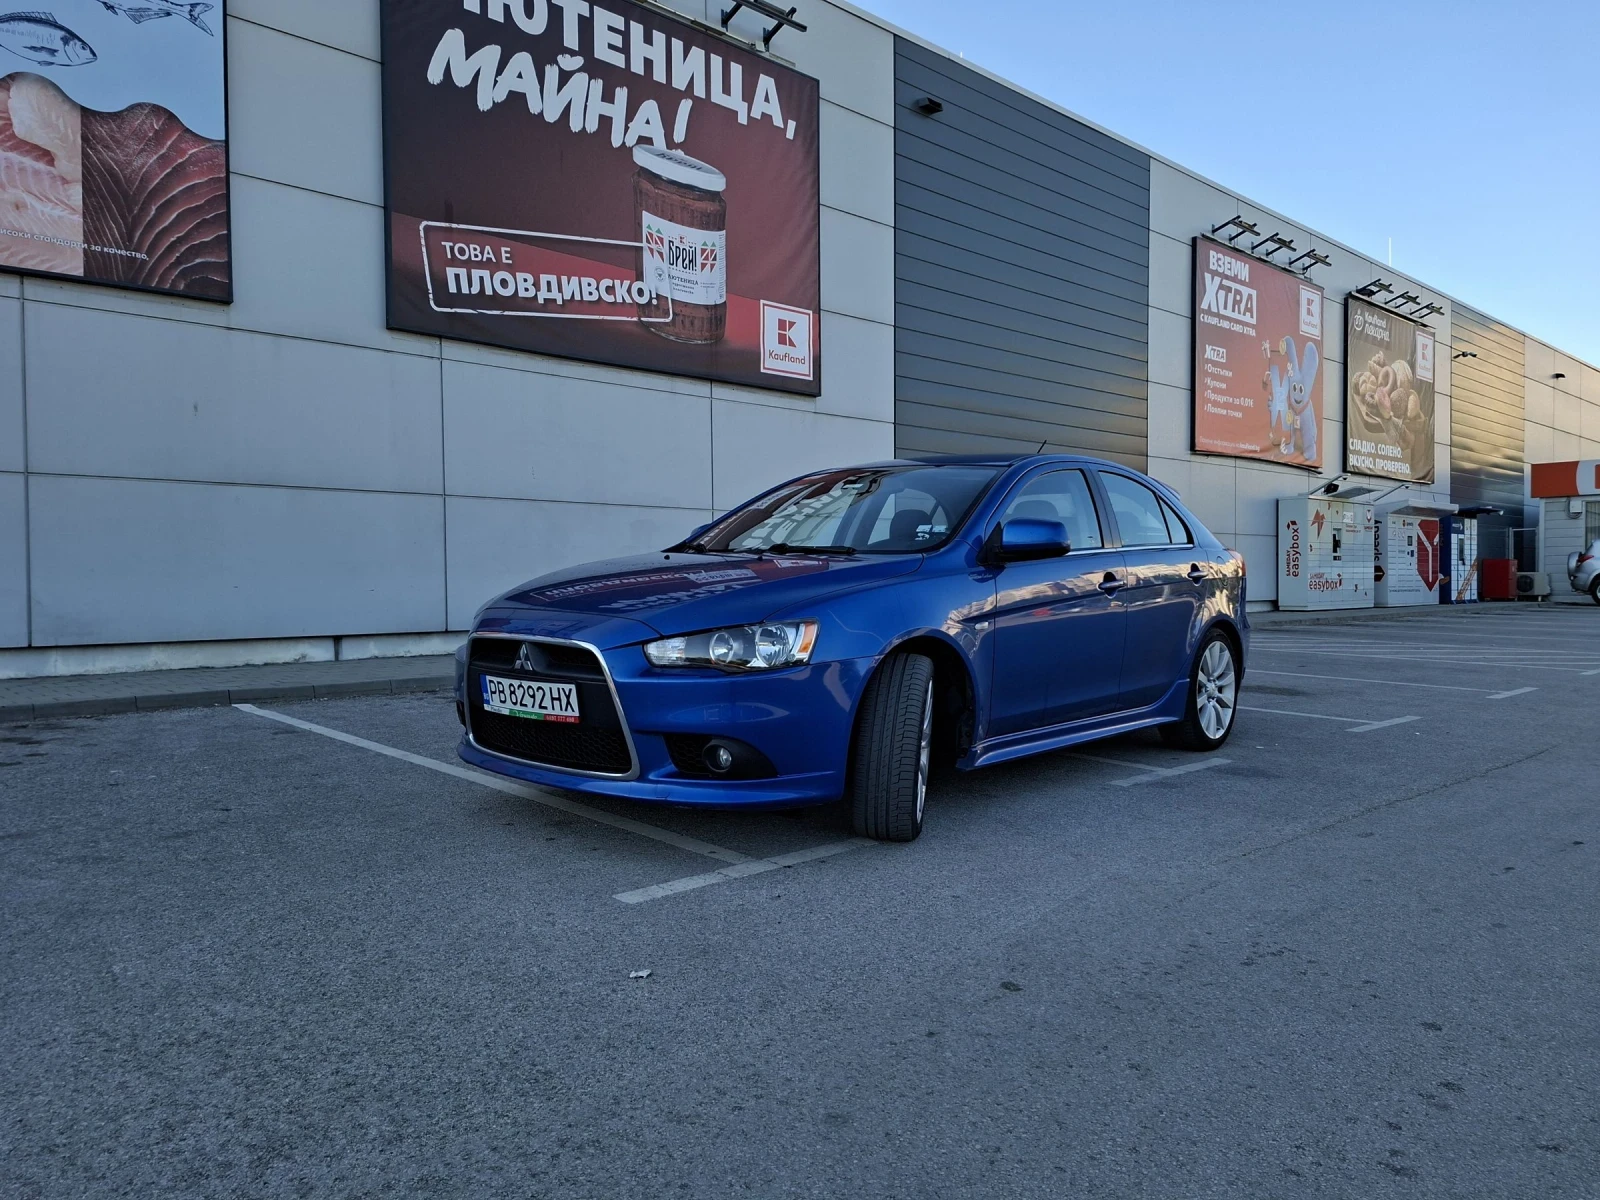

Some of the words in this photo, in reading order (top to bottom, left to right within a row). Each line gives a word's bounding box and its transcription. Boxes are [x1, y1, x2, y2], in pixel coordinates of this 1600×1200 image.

[463, 0, 796, 140] ЮТЕНИЦА,
[427, 28, 692, 154] МАЙНА!
[441, 242, 497, 263] ТОВА
[501, 246, 513, 264] Е
[1209, 250, 1249, 282] ВЗЕМИ
[446, 267, 657, 305] ПЛОВДИВСКО!
[1204, 315, 1231, 329] KAUFLAND
[1230, 322, 1243, 333] CARD
[1243, 326, 1256, 337] XTRA
[769, 350, 806, 365] Kaufland
[1349, 438, 1377, 454] СЛАДКО.
[1377, 443, 1403, 459] СОЛЕНО.
[1349, 453, 1375, 469] ВКУСНО.
[1375, 458, 1412, 474] ПРОВЕРЕНО.
[1290, 527, 1301, 578] easybox
[1308, 577, 1338, 592] easybox
